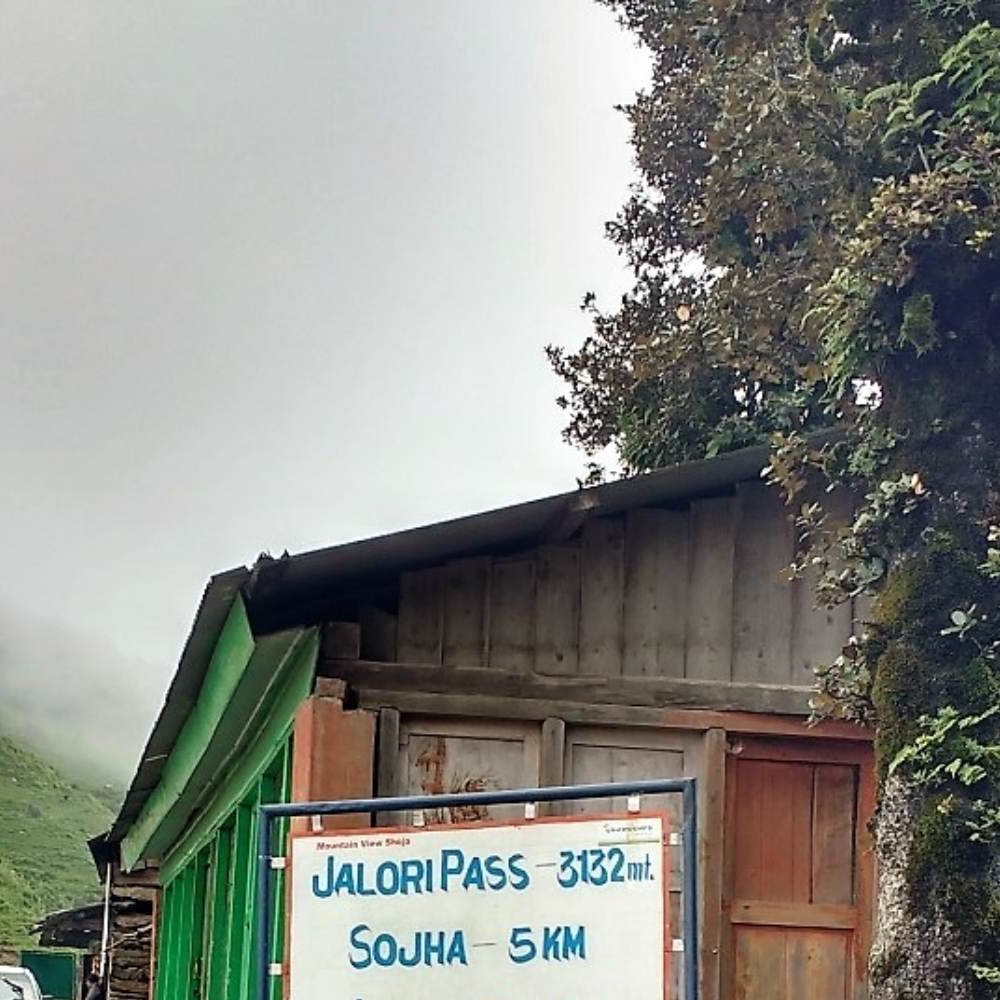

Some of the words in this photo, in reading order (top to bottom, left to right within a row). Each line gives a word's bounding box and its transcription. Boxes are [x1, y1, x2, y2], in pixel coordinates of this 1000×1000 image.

[313, 856, 433, 898] JALORI
[441, 850, 529, 891] PASS
[350, 925, 468, 969] SOJHA
